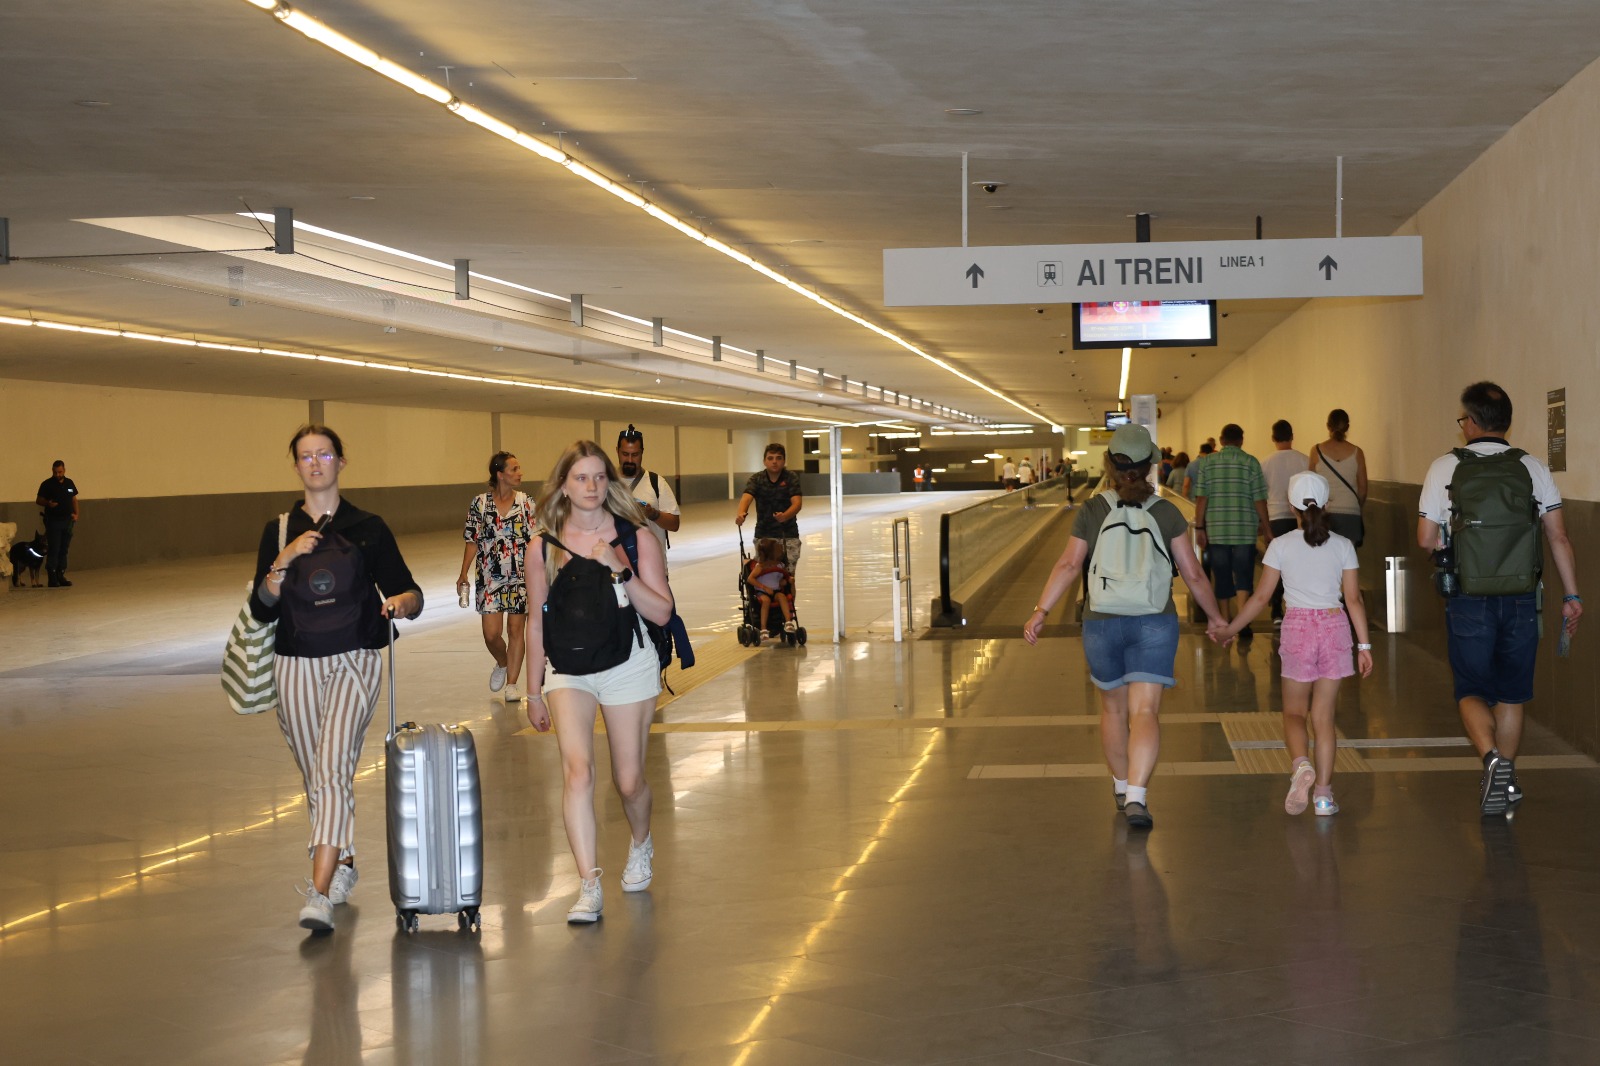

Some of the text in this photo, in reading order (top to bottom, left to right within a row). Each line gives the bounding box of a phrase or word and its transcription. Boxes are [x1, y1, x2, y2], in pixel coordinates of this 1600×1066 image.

[1077, 257, 1203, 286] AI TRENI
[1220, 255, 1264, 268] LINEA 1
